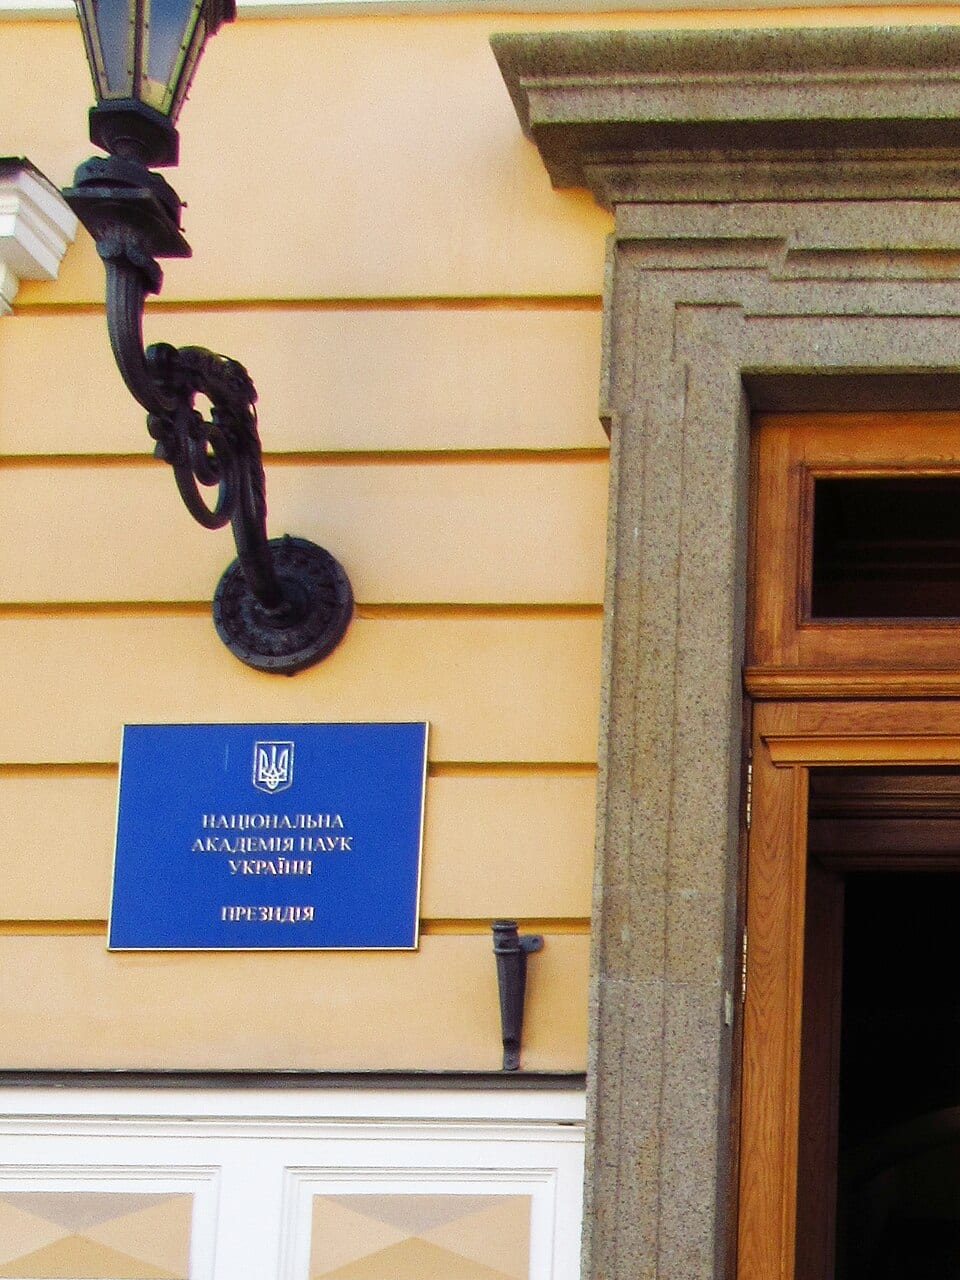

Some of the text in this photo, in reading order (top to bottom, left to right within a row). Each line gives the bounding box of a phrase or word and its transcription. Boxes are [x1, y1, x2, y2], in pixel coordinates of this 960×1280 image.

[202, 813, 344, 830] НАЦІОНАЛЬНА
[191, 836, 353, 853] АКАДЕМІЯ НАУК
[228, 857, 313, 875] УКРАЇНИ
[221, 906, 315, 923] ПРЕЗИДІЯ
